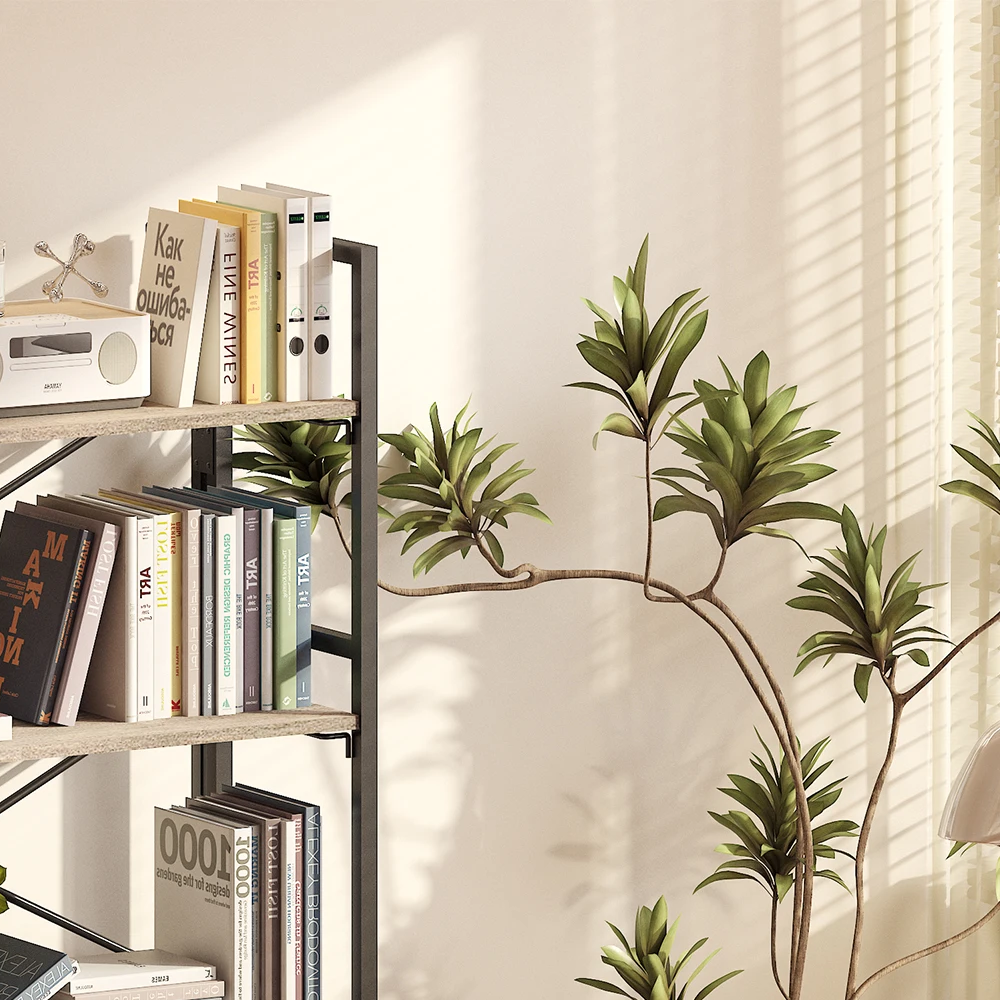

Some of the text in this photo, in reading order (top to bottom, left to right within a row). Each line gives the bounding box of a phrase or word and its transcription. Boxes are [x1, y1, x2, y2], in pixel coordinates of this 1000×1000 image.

[154, 222, 184, 261] Как
[155, 263, 175, 288] не
[135, 285, 191, 321] ошиба-
